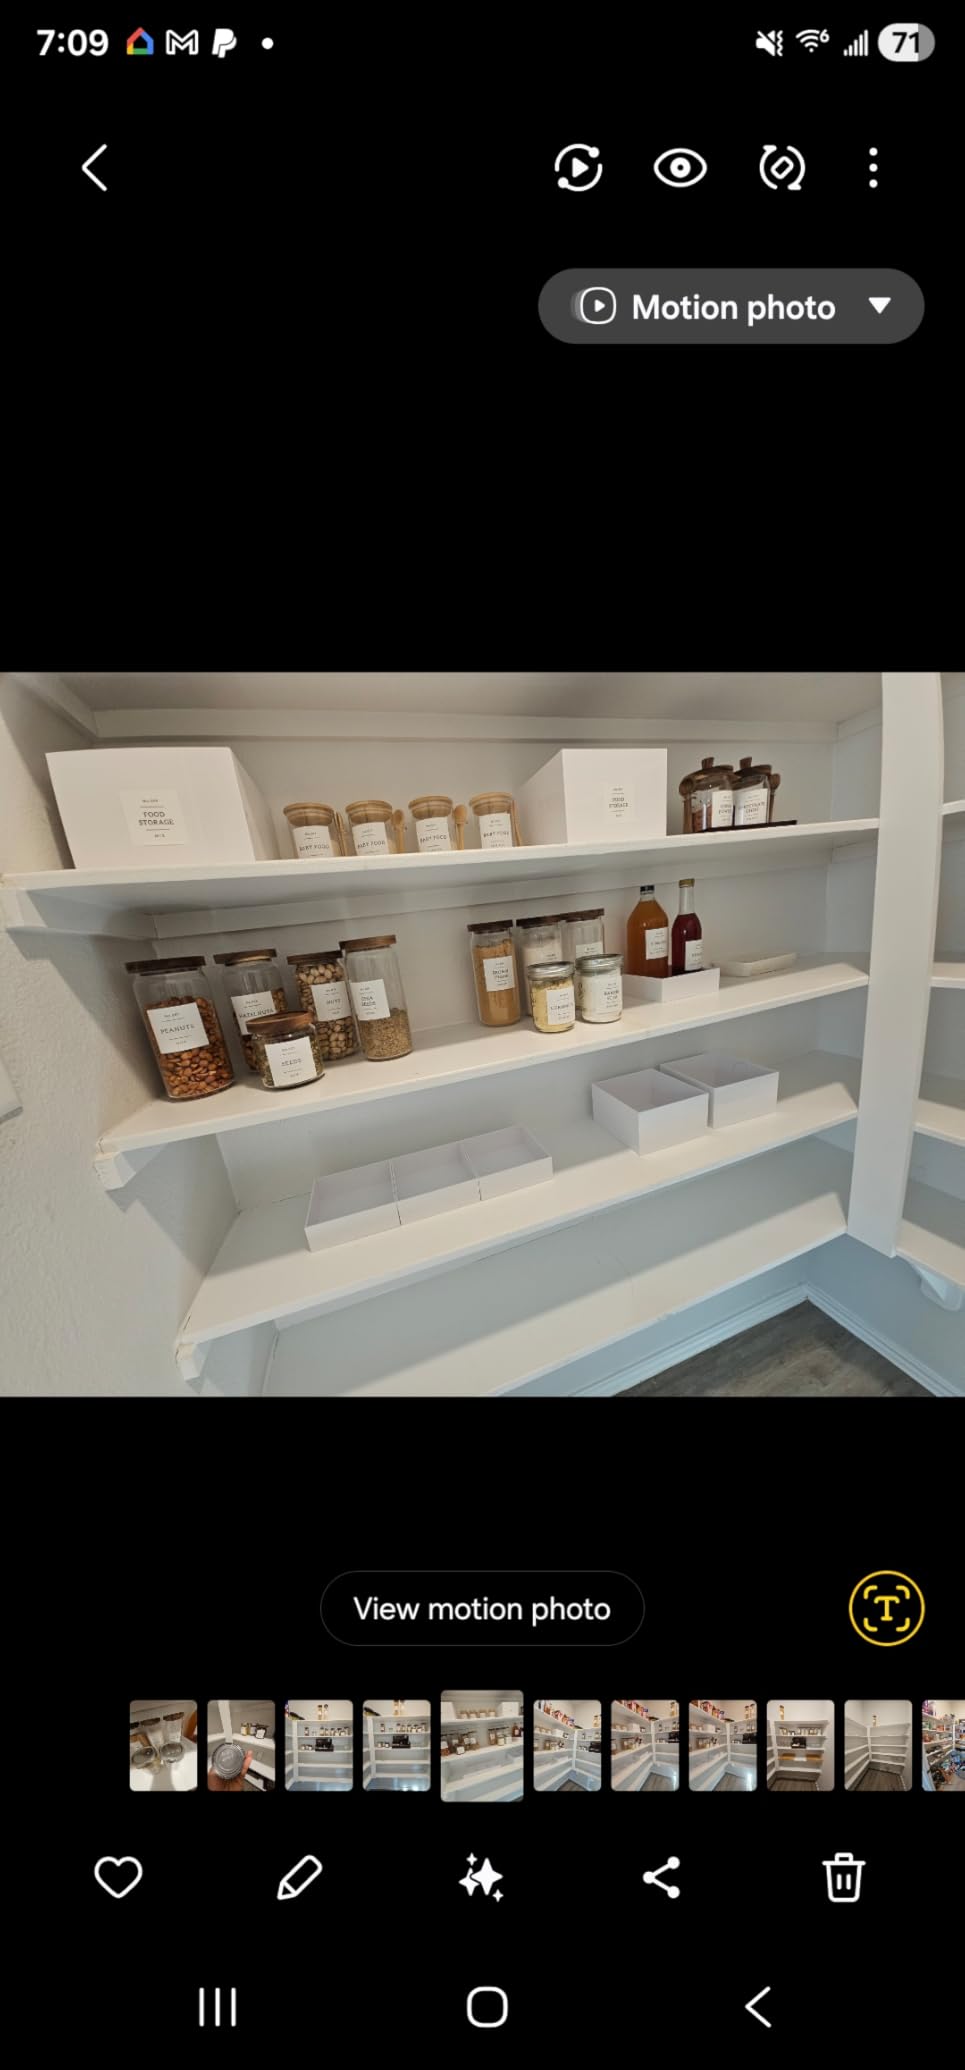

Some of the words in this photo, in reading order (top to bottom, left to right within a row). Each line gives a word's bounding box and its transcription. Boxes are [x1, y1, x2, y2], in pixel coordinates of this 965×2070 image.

[37, 30, 108, 56] 7:09
[892, 31, 919, 54] 71
[633, 293, 738, 320] Motion
[747, 293, 836, 327] photo
[160, 1024, 195, 1034] PEANUTS
[353, 1597, 420, 1621] View
[429, 1597, 523, 1620] motion
[532, 1597, 611, 1627] photo
